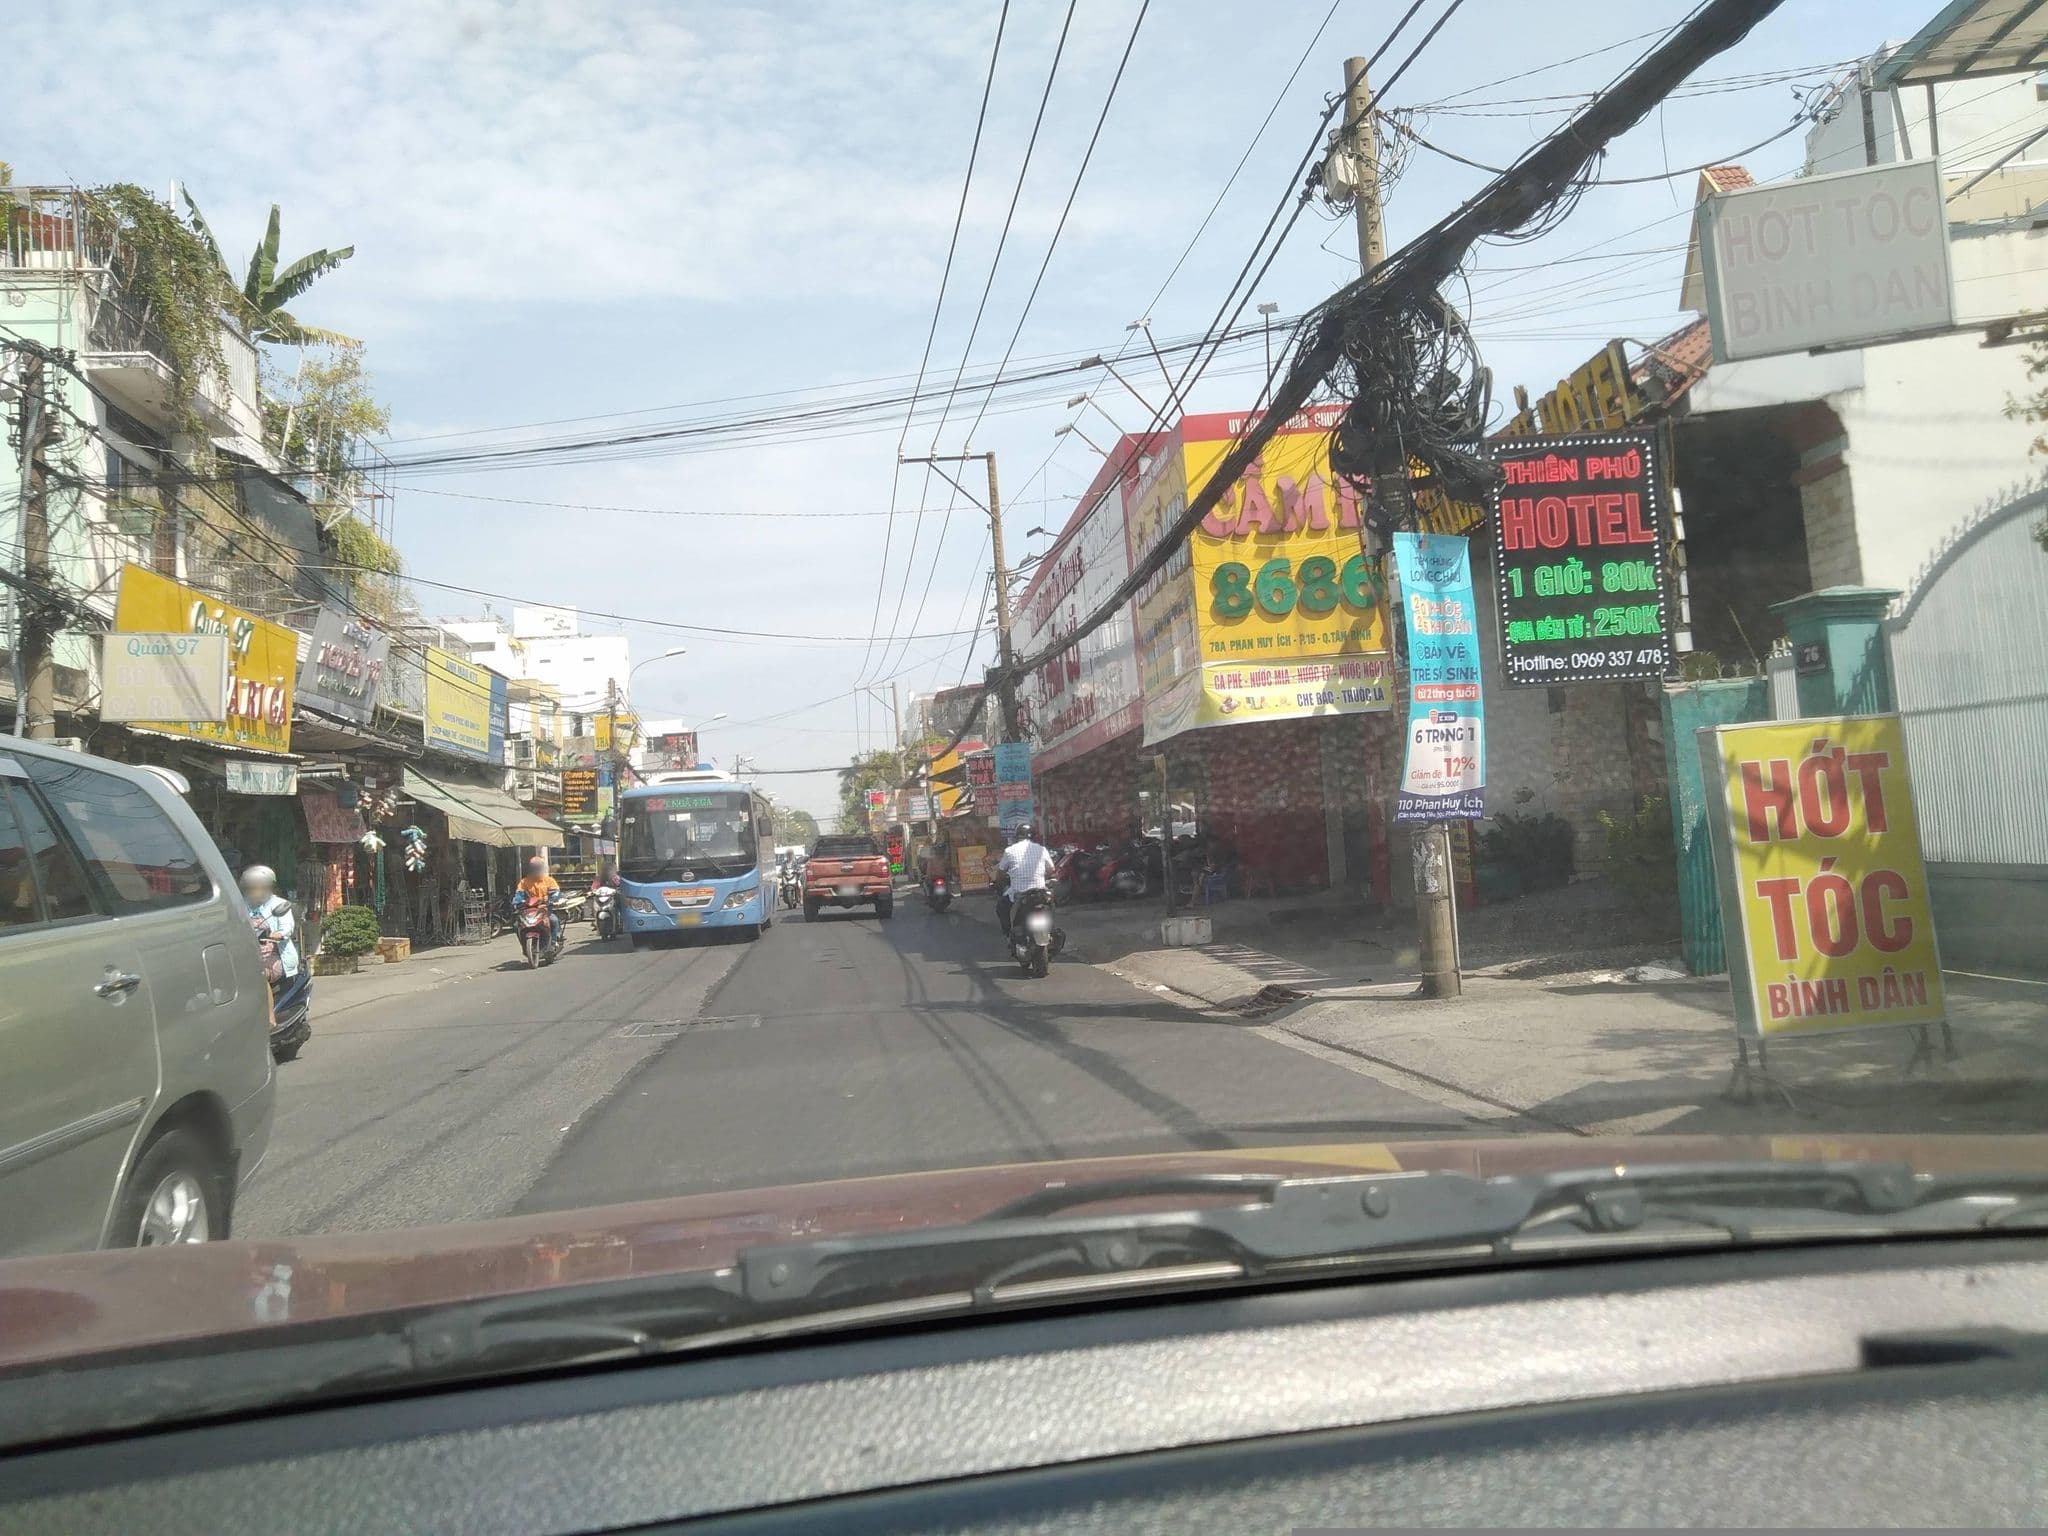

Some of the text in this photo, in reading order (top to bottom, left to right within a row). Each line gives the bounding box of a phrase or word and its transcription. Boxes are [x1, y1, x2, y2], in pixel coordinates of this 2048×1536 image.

[1722, 178, 1935, 268] HỚT TÓC
[1503, 448, 1641, 485] THIÊN PHÚ
[1501, 492, 1655, 550] HOTEL
[1213, 553, 1382, 618] 8686
[1508, 567, 1523, 597] 1
[1534, 557, 1593, 597] GIỜ:
[127, 638, 200, 656] Quán 97
[1230, 638, 1254, 651] PHAN
[1257, 636, 1273, 649] HUY
[1277, 632, 1291, 647] ÍCH
[1446, 642, 1465, 662] VỆ
[1447, 667, 1479, 681] SINH
[1514, 648, 1662, 672] Hotline: 0969 337 478
[1415, 729, 1423, 743] 6
[1468, 728, 1475, 741] 1
[1411, 769, 1431, 780] Giảm
[1444, 756, 1475, 778] 12%
[1398, 794, 1483, 810] 110 Phan Huy Ích
[1740, 738, 1889, 843] HỚT
[1756, 857, 1914, 963] TÓC
[1768, 966, 1928, 1020] BÌNH DÂN
